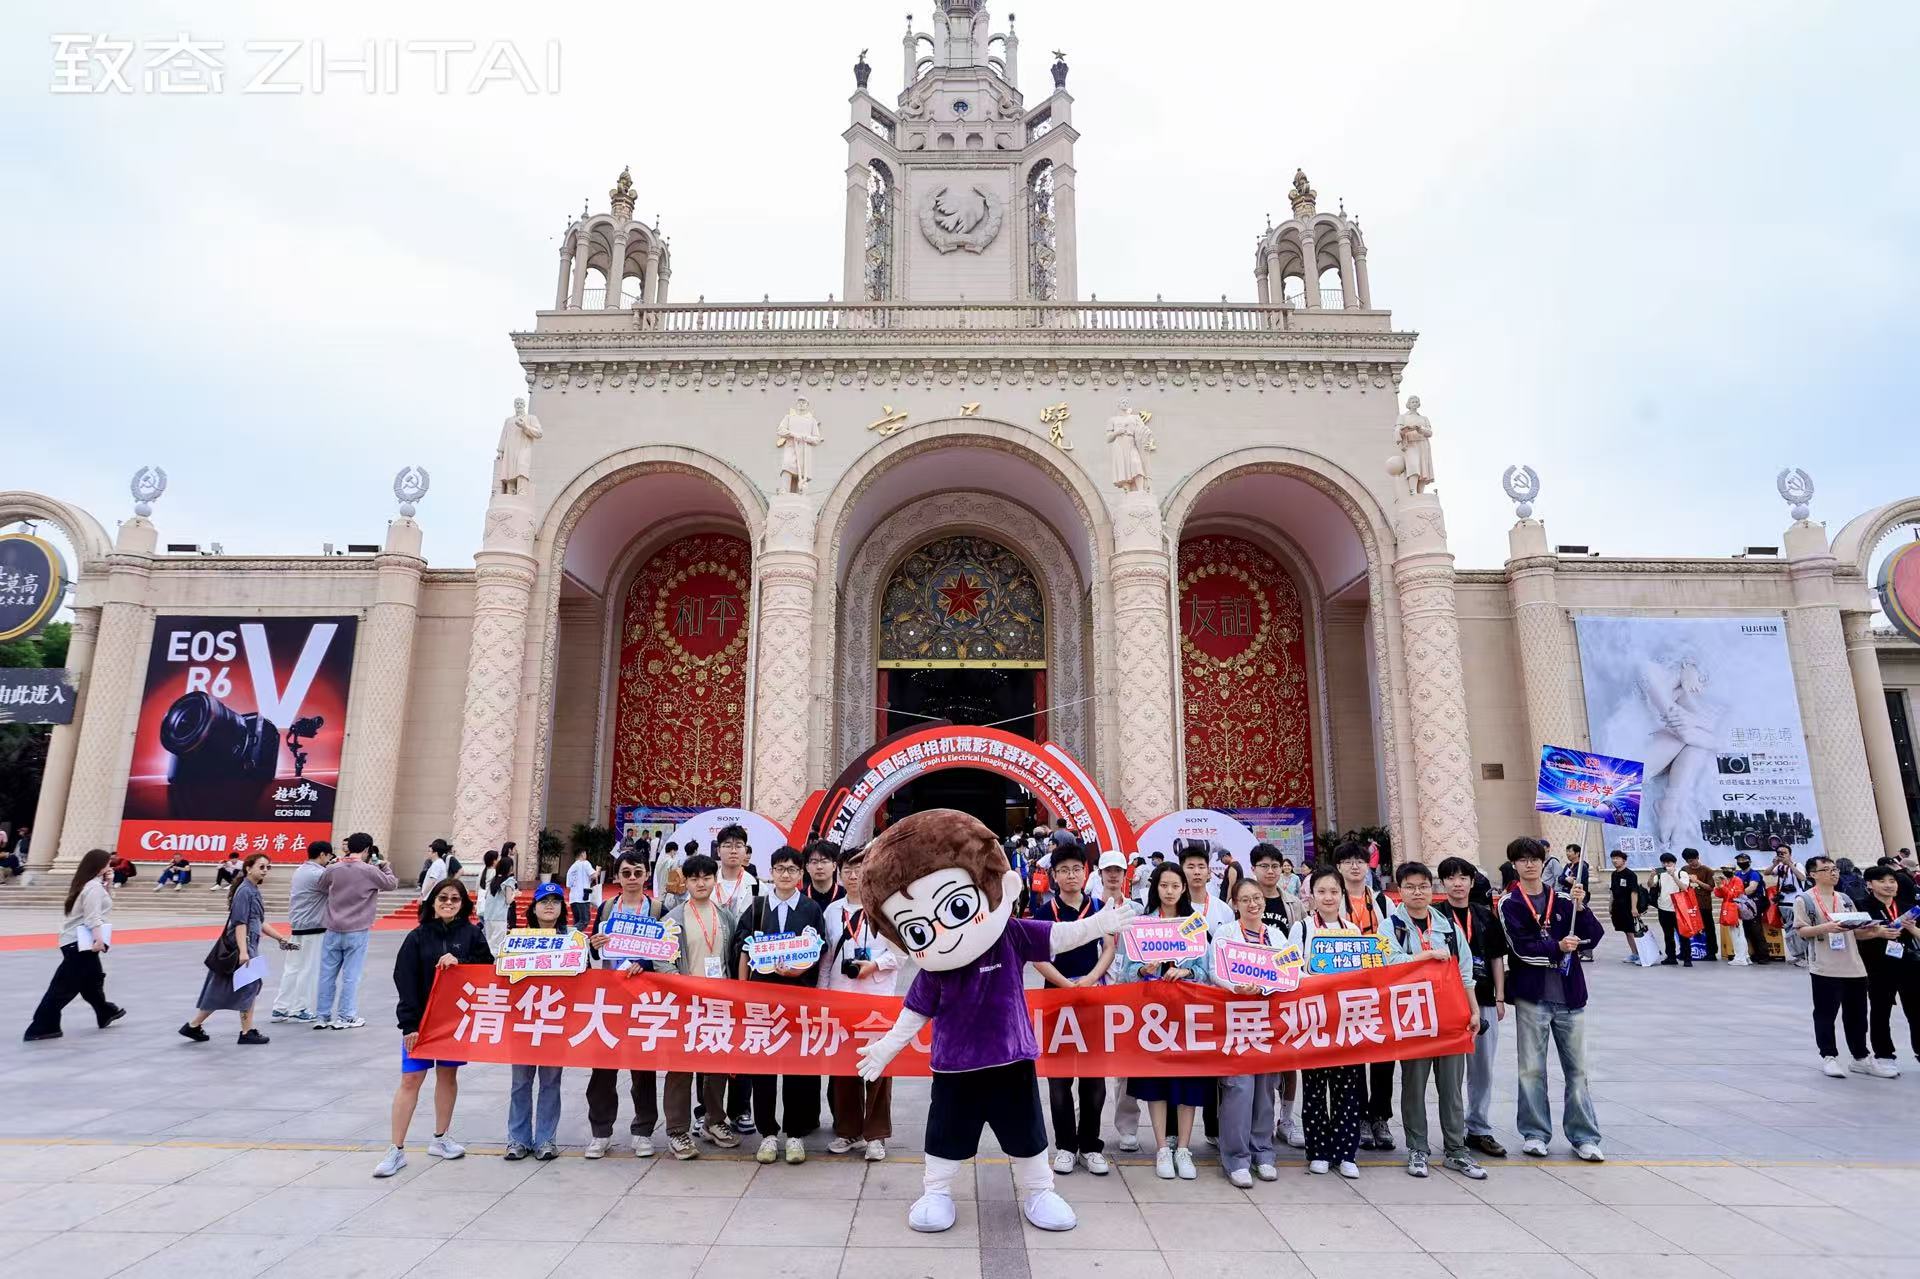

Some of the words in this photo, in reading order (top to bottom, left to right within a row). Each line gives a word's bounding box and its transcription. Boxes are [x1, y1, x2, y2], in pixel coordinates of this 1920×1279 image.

[671, 595, 738, 637] 和平
[167, 631, 237, 662] EOS
[186, 667, 232, 698] R6
[239, 623, 339, 729] V
[855, 803, 870, 822] China
[866, 771, 904, 804] International
[902, 756, 940, 777] Photograph
[981, 755, 1009, 770] Imaging
[1008, 764, 1040, 788] Machinery
[1039, 784, 1051, 797] and
[1050, 794, 1074, 830] Technology
[1567, 779, 1614, 796] 清华大学
[1722, 793, 1757, 801] GFX
[274, 809, 294, 817] EOS
[140, 830, 227, 851] Canon
[232, 832, 307, 851] 感动常在
[508, 937, 564, 949] 咔嚓定格
[608, 937, 672, 957] 存这绝对安全
[1141, 941, 1187, 952] 2000MB
[1315, 941, 1370, 953] 什么都吃得下
[1231, 962, 1278, 981] 2000MB
